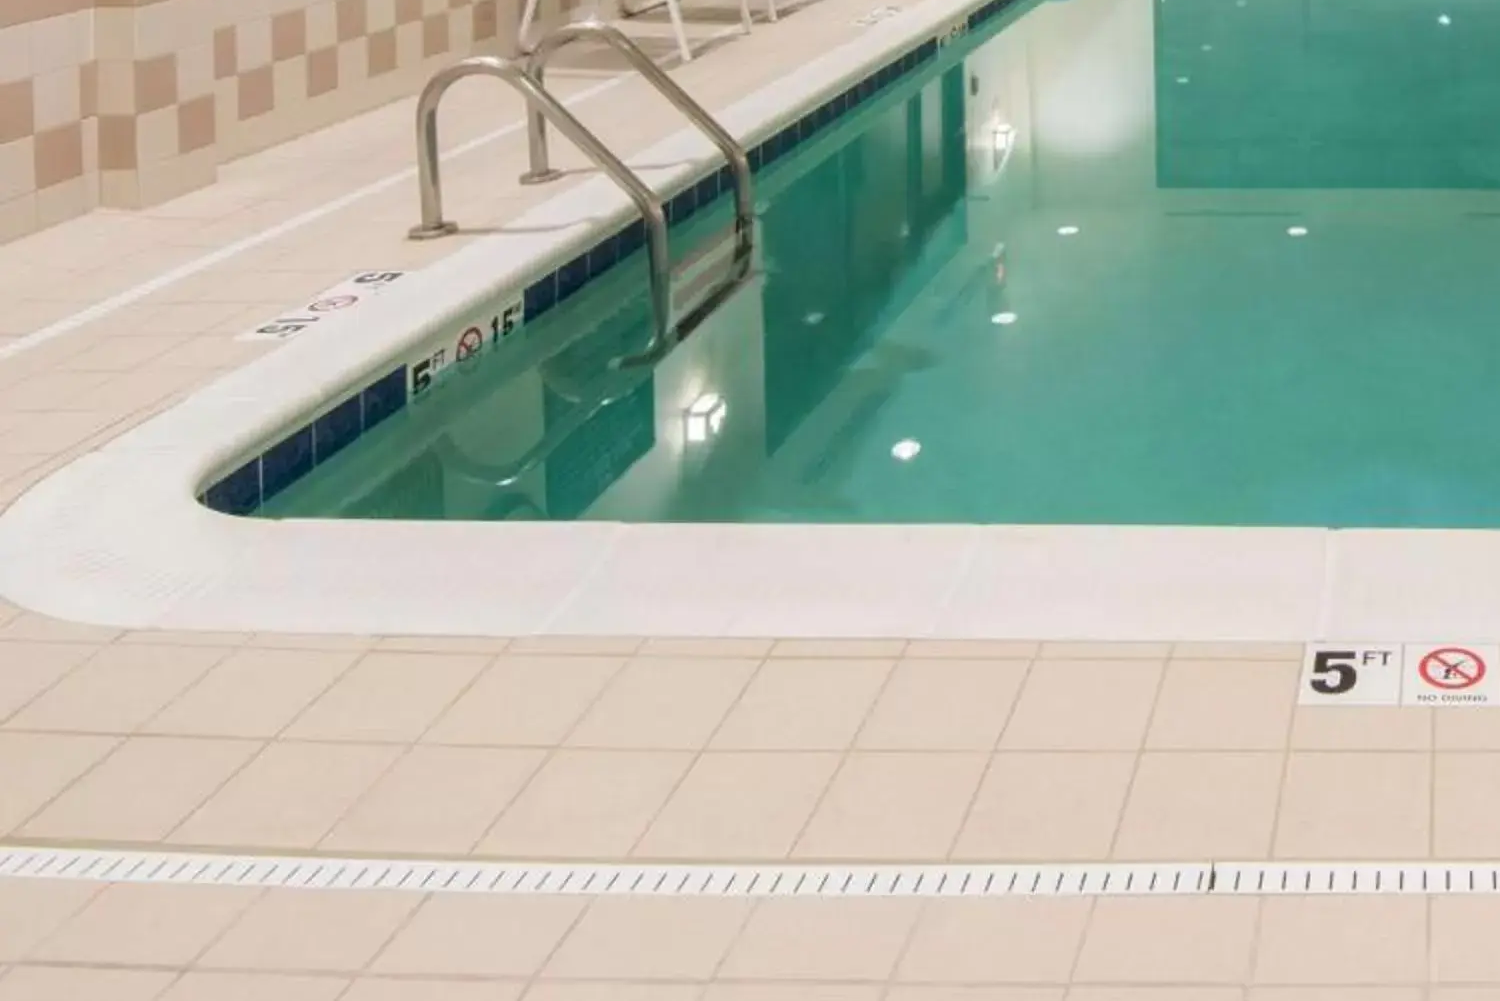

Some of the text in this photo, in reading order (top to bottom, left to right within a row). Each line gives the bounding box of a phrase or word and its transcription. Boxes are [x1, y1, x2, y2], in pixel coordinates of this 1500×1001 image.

[1310, 651, 1357, 695] 5
[1362, 650, 1393, 666] FT
[1417, 694, 1488, 702] NO DIVING
